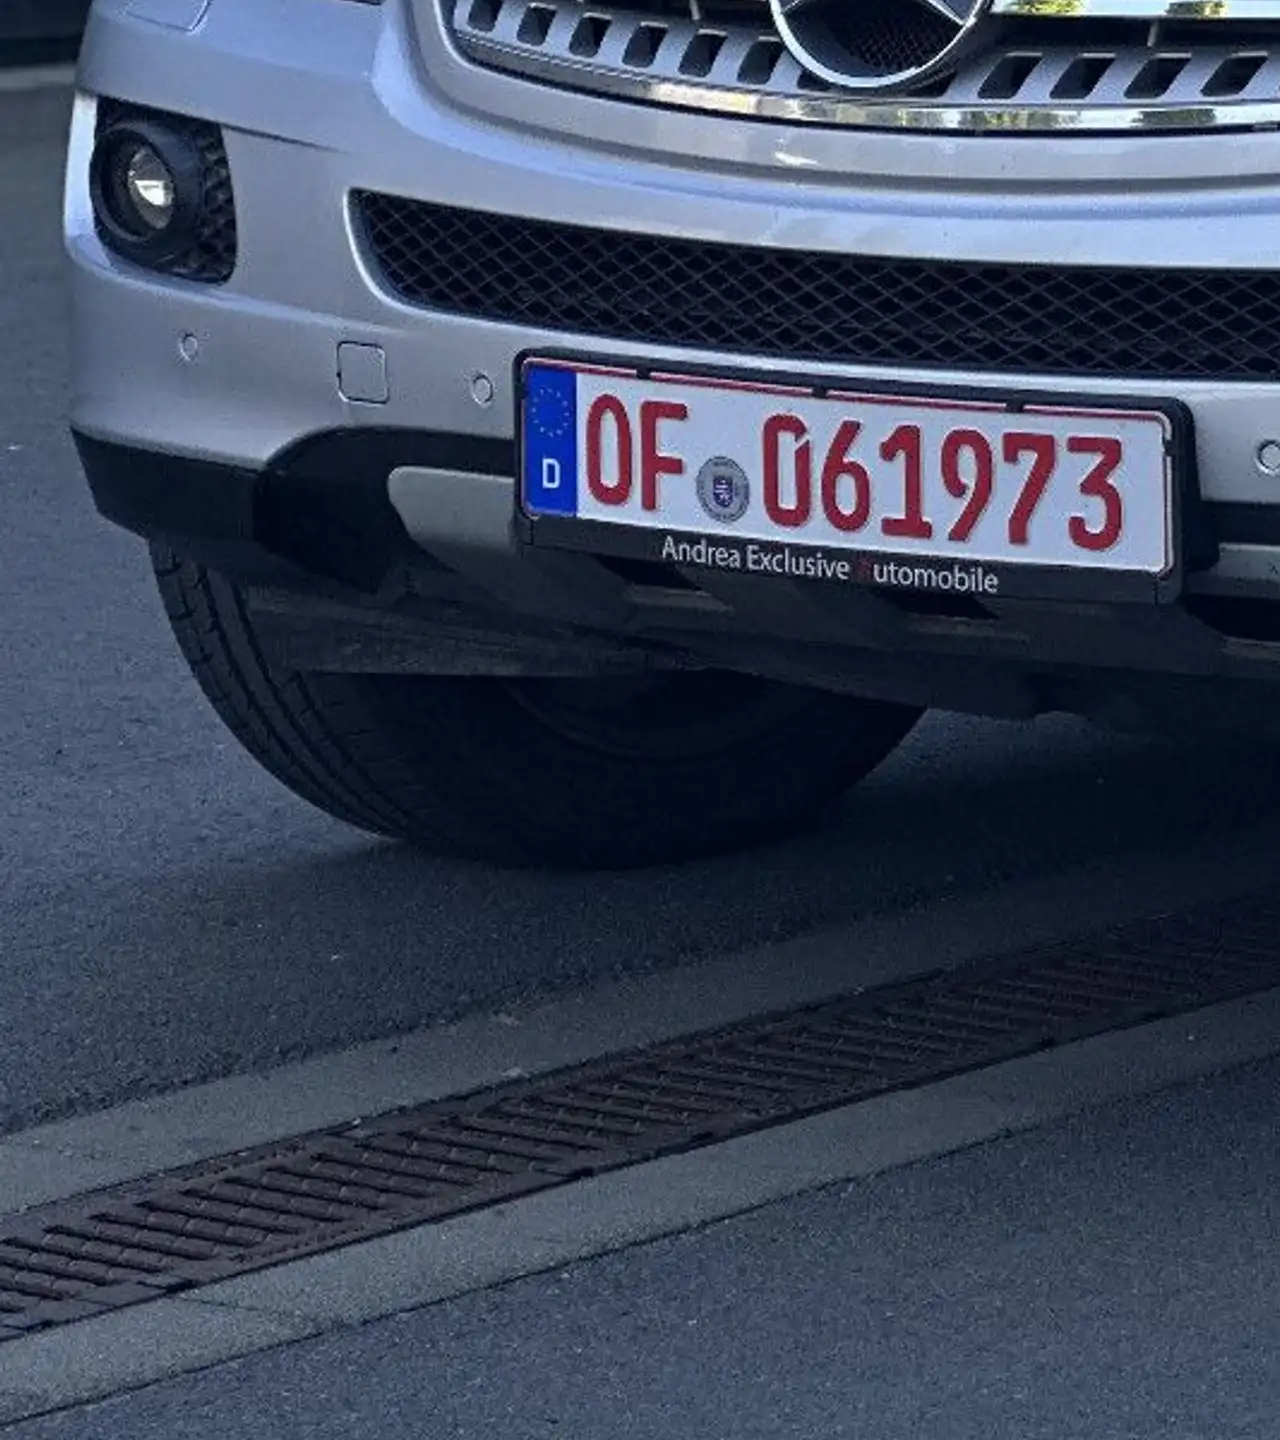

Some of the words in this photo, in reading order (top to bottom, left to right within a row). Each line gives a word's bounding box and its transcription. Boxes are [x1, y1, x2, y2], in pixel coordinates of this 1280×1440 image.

[542, 458, 561, 489] D
[586, 394, 688, 511] OF
[763, 413, 1123, 551] 061973
[662, 535, 741, 568] Andrea
[746, 544, 850, 581] Exclusive
